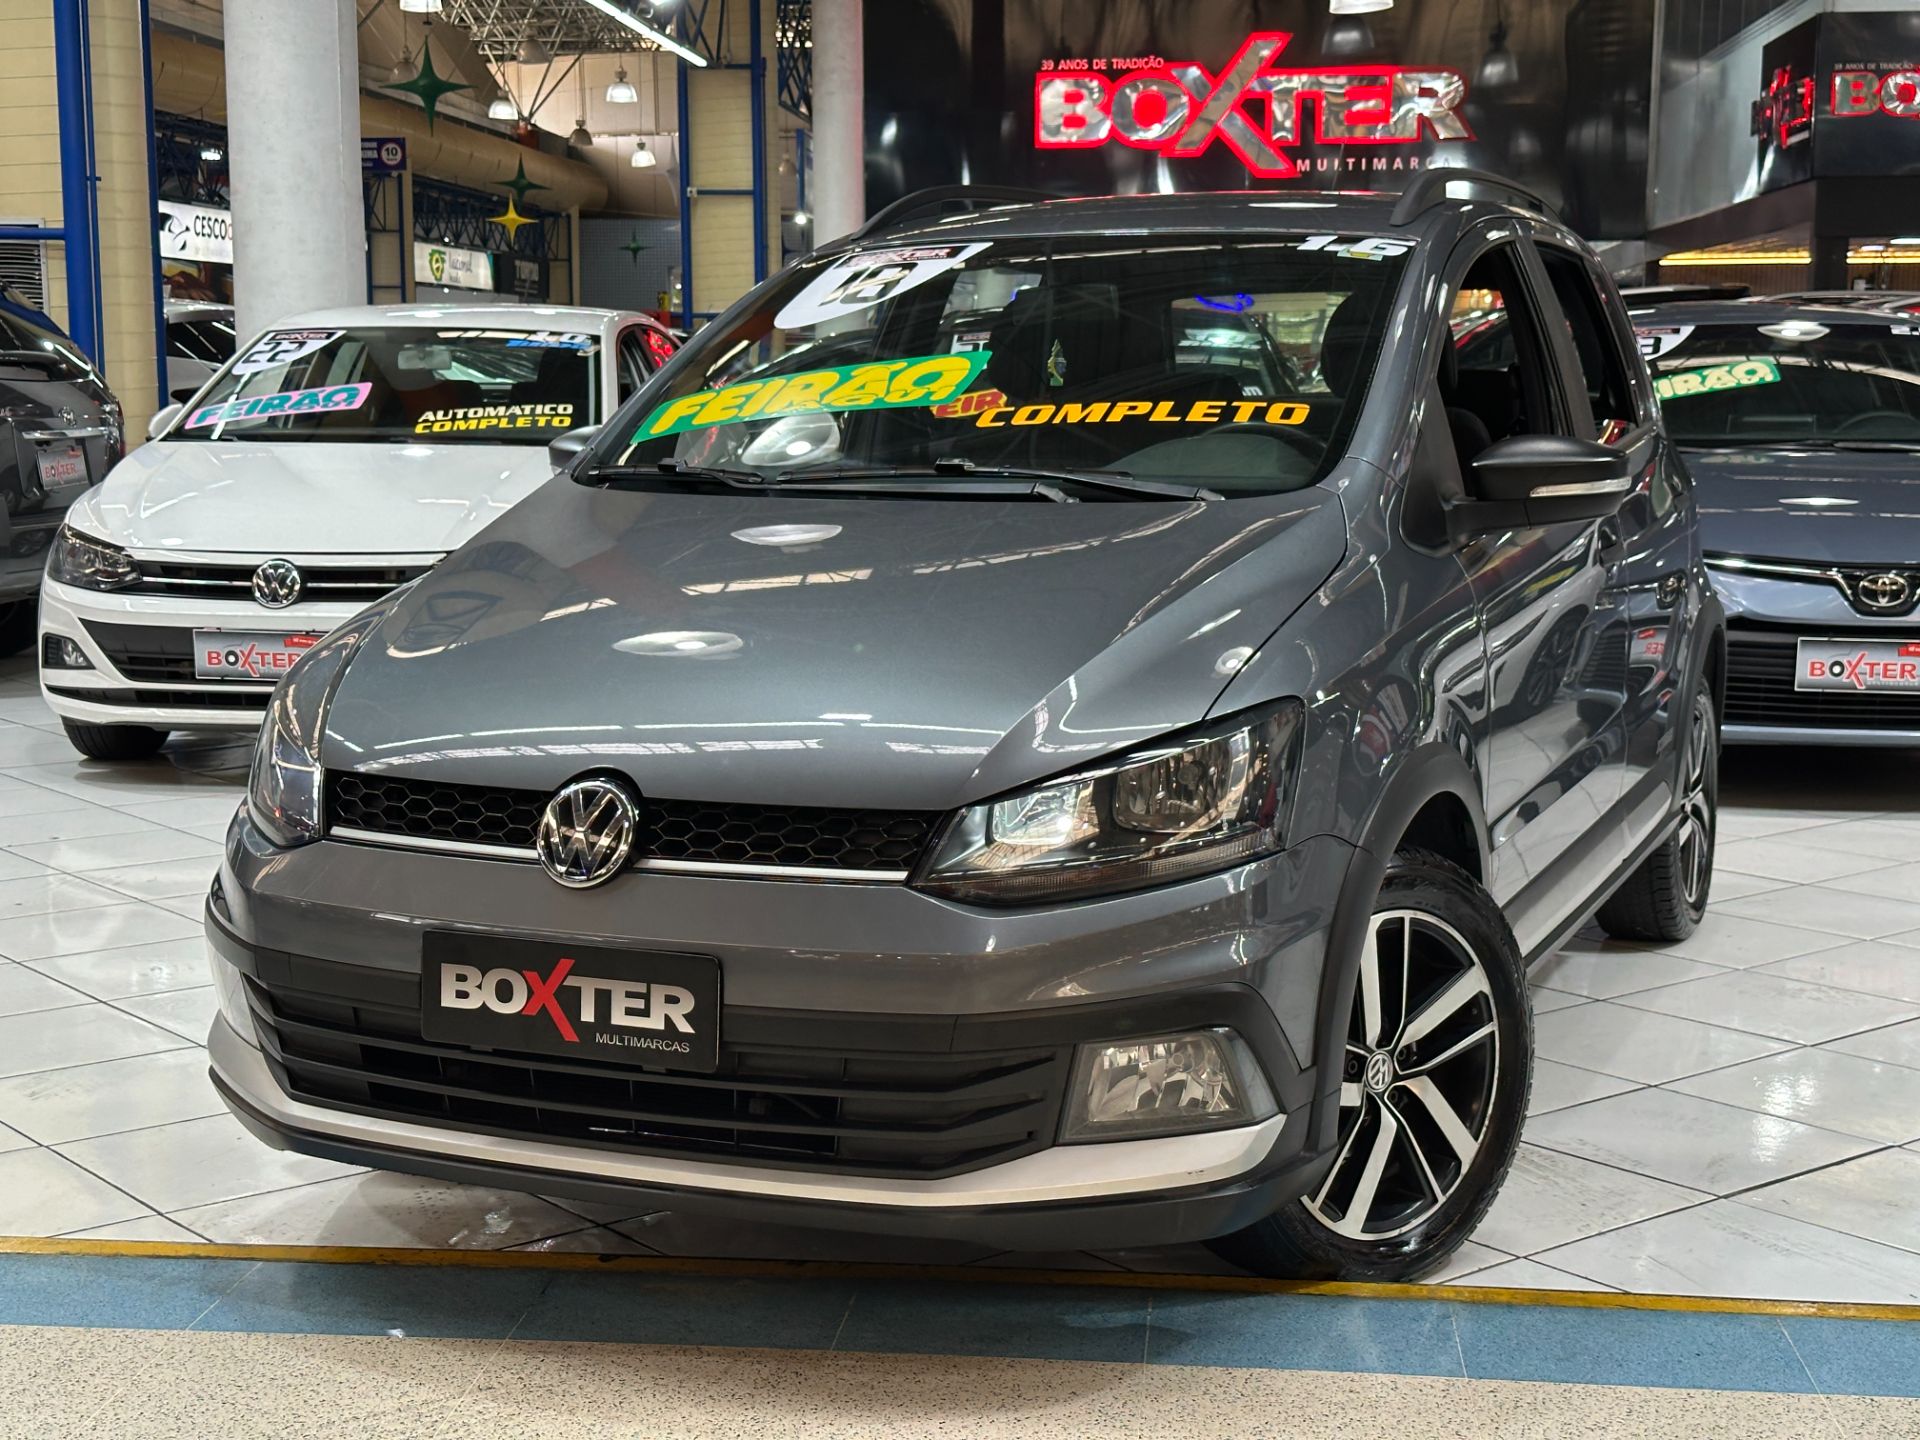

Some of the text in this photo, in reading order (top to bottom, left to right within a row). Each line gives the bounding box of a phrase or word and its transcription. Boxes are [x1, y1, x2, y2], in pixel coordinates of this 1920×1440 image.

[1041, 55, 1164, 71] 39 ANOS DE TRADIÇÃO
[1035, 32, 1477, 178] BOXTER
[1830, 69, 1920, 119] BO
[384, 146, 398, 157] 10
[1297, 235, 1417, 256] 1.6
[241, 341, 308, 364] 22
[650, 356, 972, 434] FEIRÃO
[415, 416, 572, 434] COMPLETO
[975, 401, 1311, 428] COMPLETO
[44, 457, 78, 485] BOXTER
[206, 642, 301, 678] BOXTER
[1807, 651, 1918, 690] BOXTER
[440, 957, 697, 1043] BOXTER
[595, 1032, 691, 1054] MULTIMARCAS
